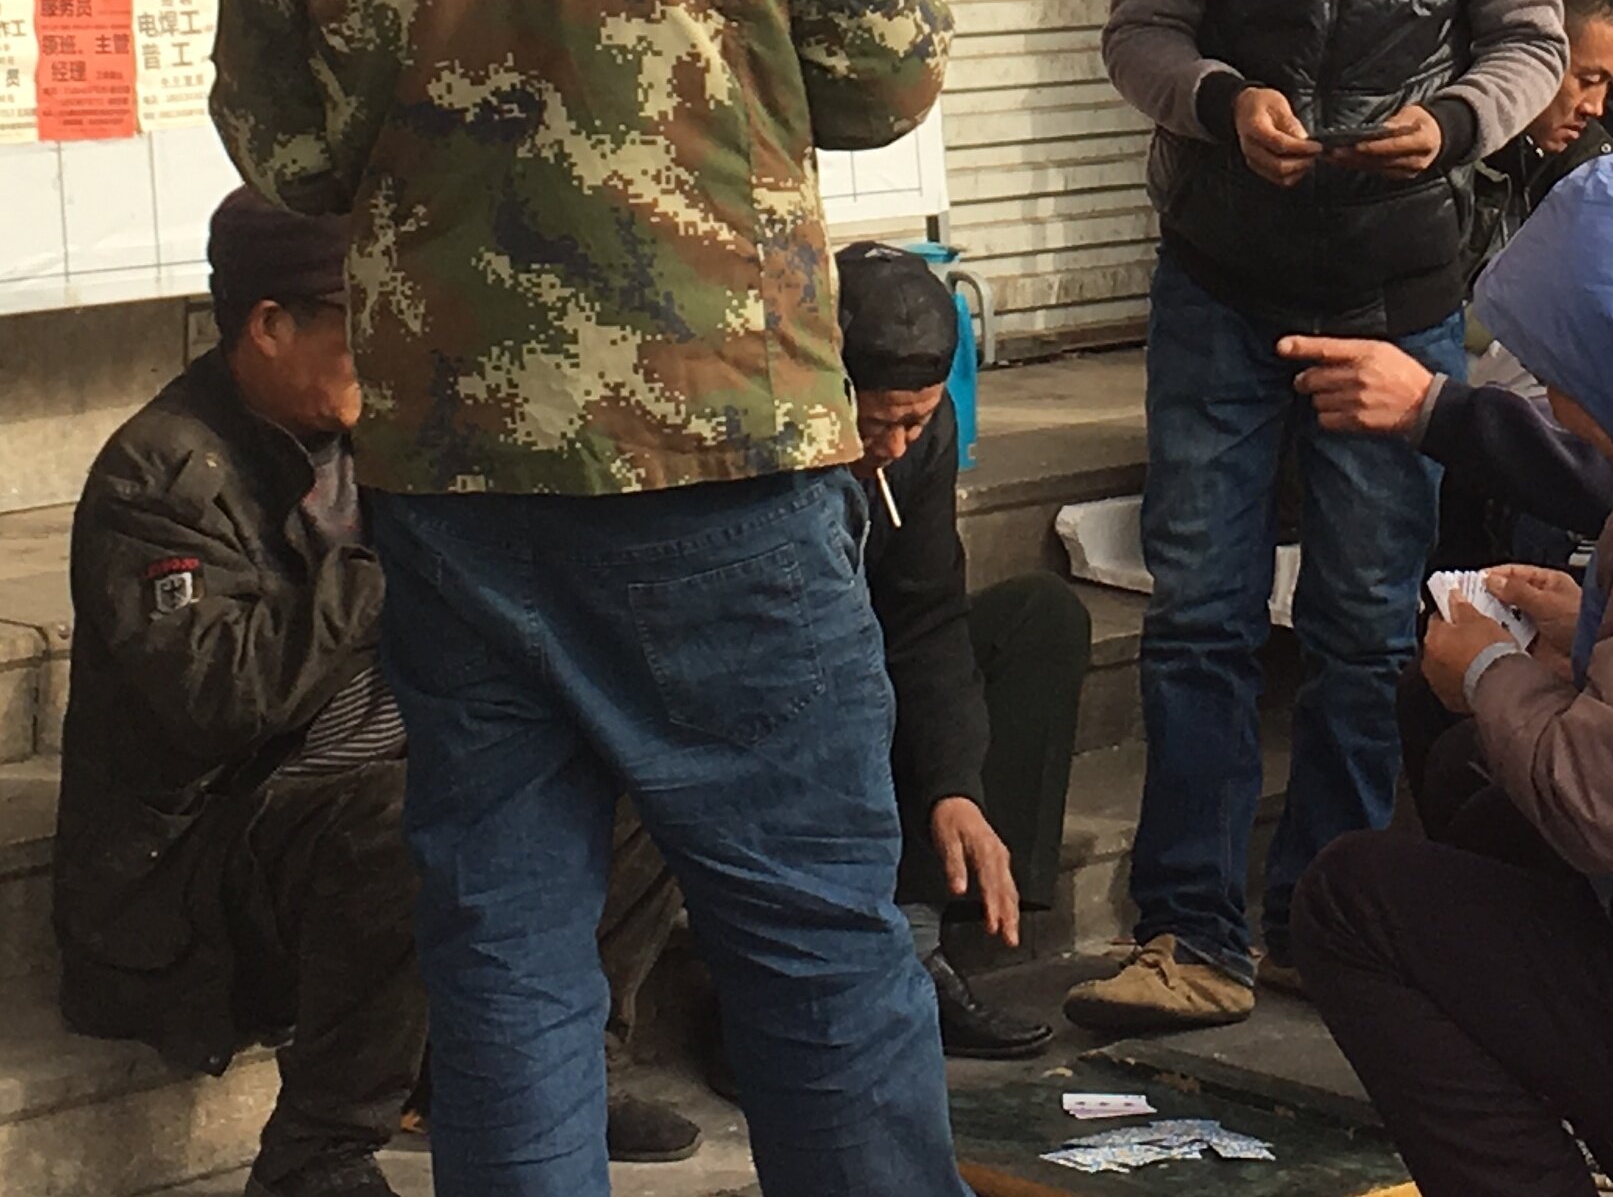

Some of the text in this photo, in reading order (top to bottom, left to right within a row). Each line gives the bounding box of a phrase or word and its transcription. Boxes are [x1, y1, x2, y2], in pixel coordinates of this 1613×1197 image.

[138, 10, 202, 36] 电焊工
[51, 60, 87, 83] 经理
